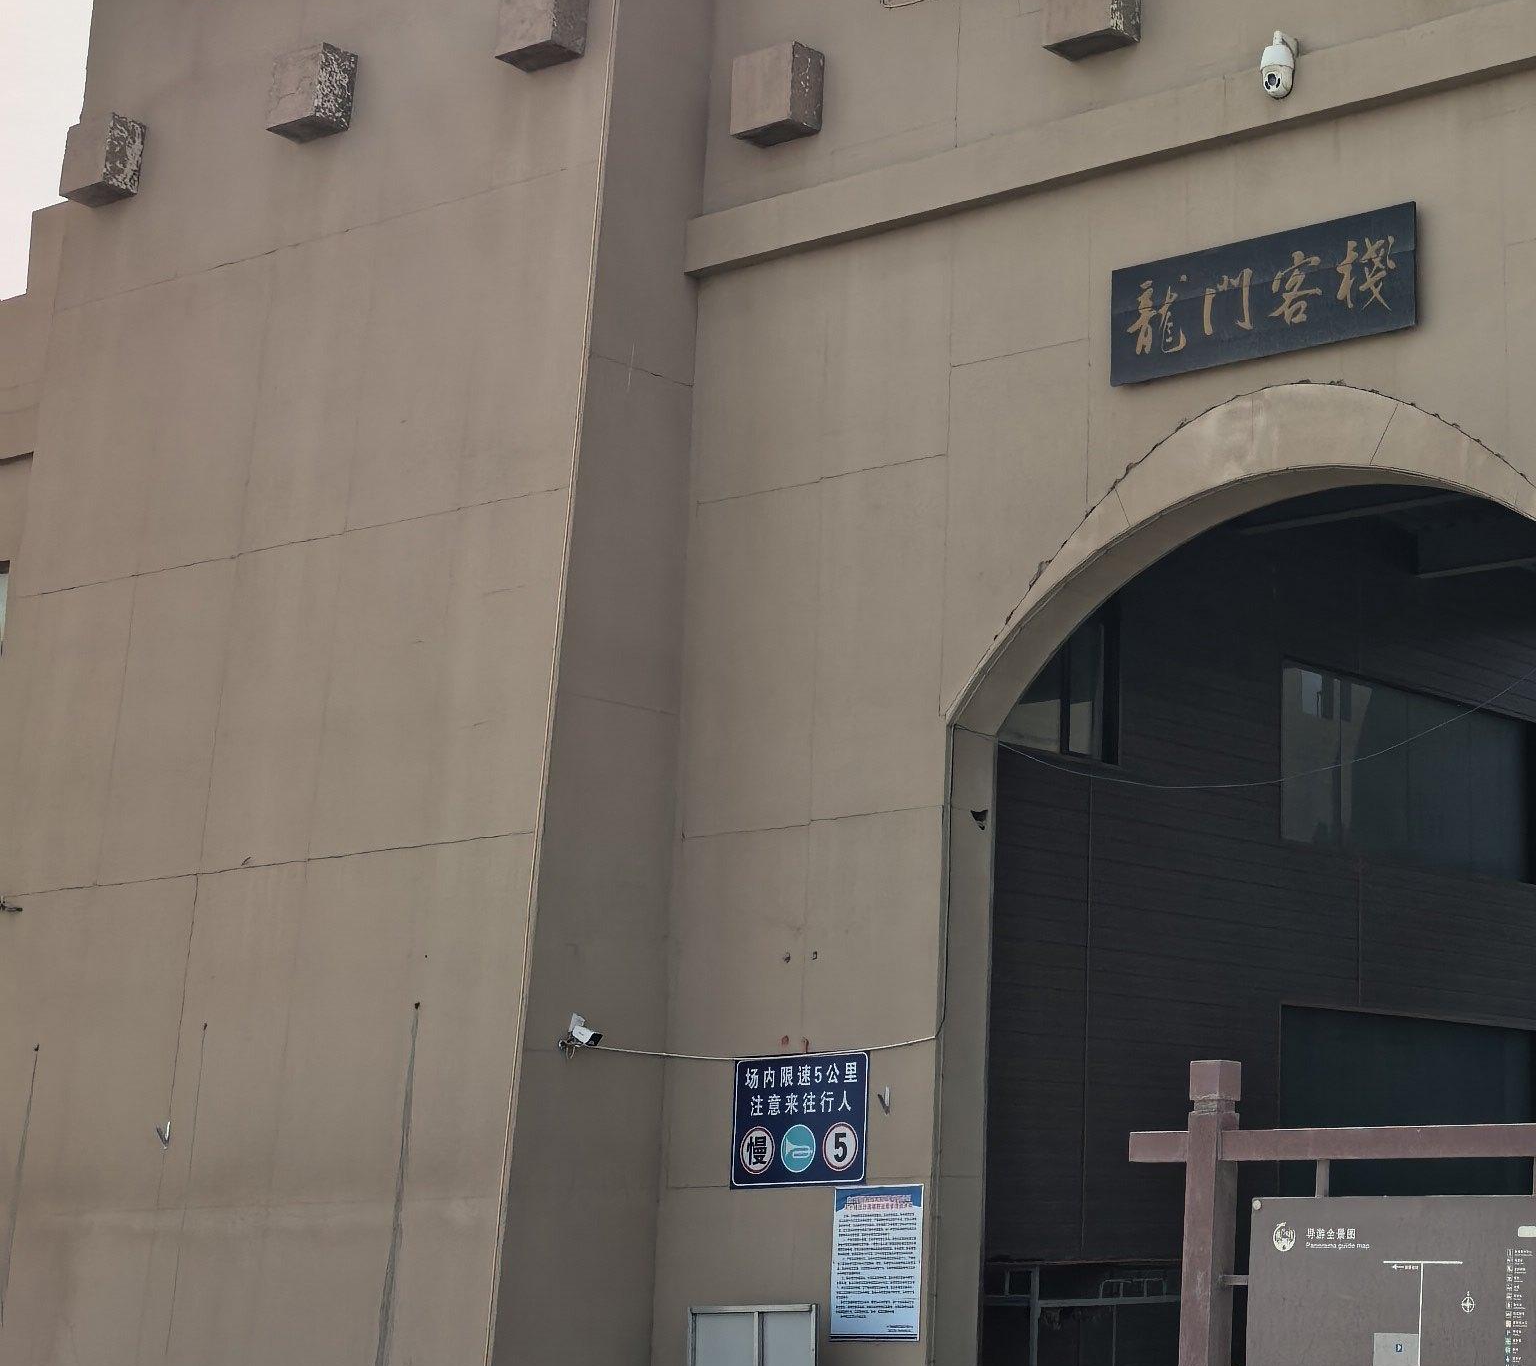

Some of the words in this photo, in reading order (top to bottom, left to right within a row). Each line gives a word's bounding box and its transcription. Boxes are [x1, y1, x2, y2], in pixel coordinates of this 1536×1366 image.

[745, 1062, 858, 1089] 场内限速5公里
[750, 1090, 852, 1117] 注意来往行人
[747, 1135, 767, 1166] 慢
[833, 1132, 848, 1163] 5
[1337, 1242, 1356, 1250] guide
